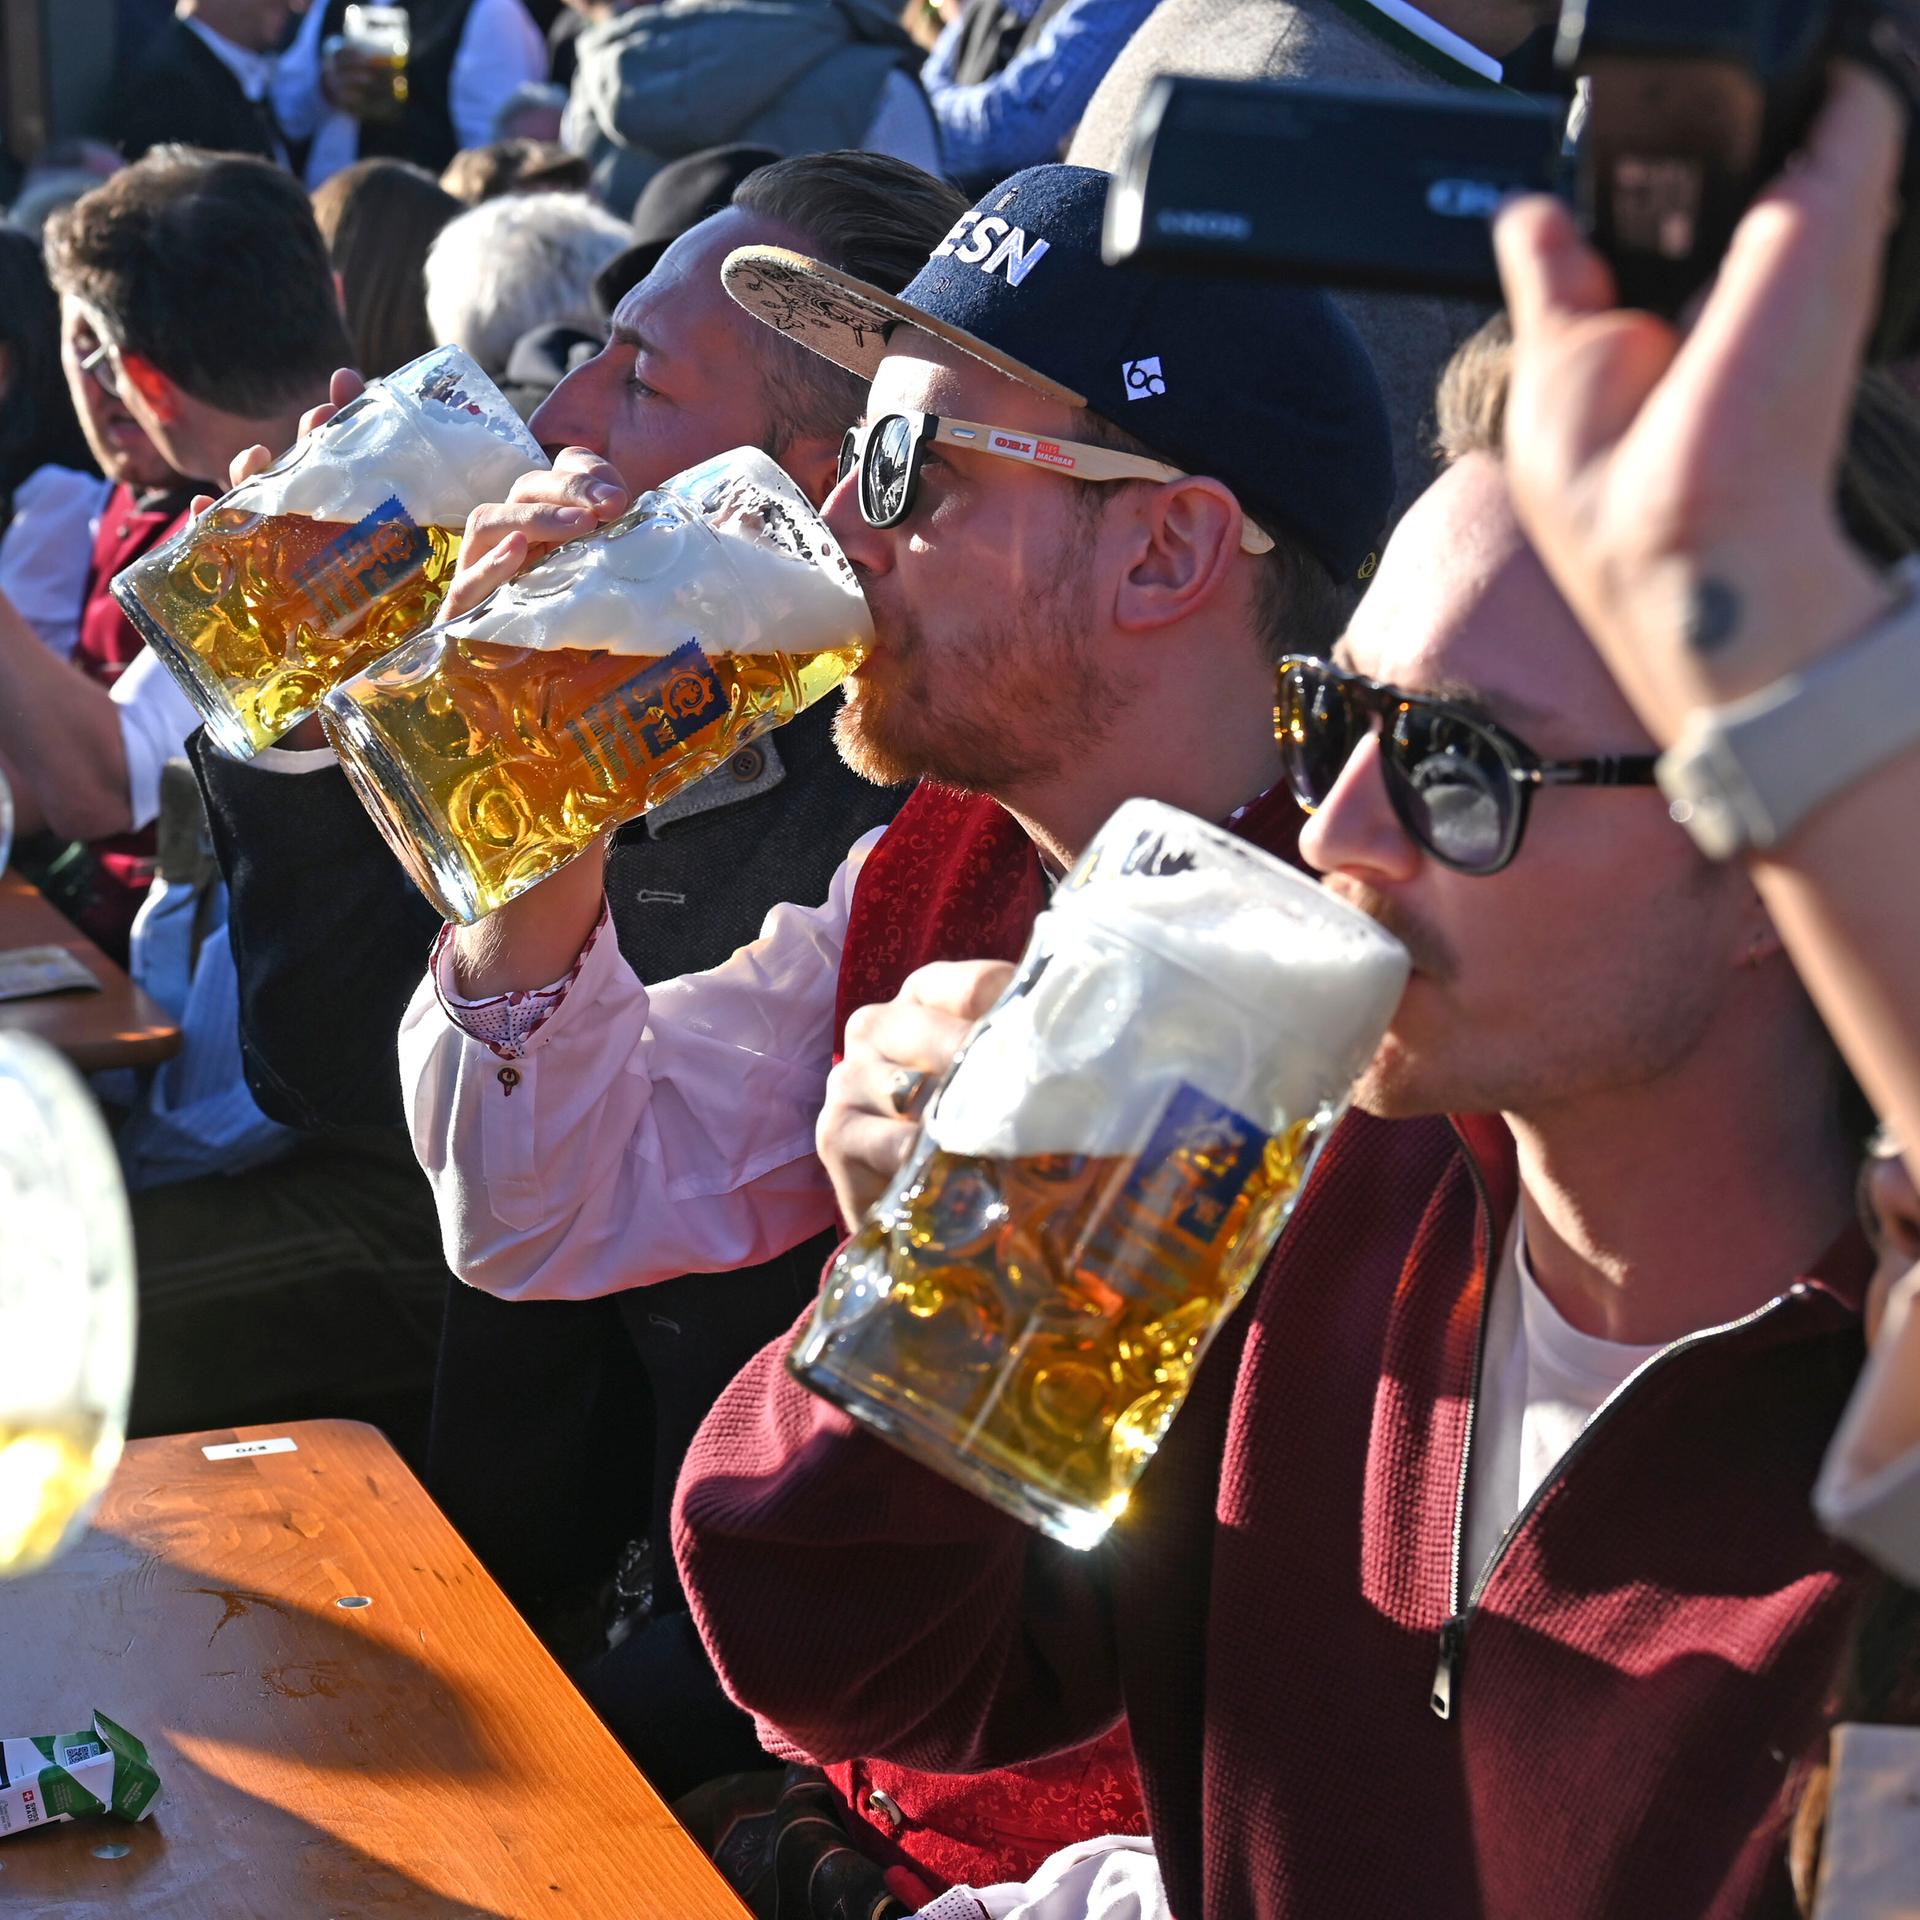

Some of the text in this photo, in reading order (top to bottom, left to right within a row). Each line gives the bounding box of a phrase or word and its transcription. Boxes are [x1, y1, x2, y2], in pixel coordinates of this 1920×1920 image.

[994, 437, 1031, 453] OBI
[1038, 443, 1058, 454] ALLES
[1036, 453, 1073, 466] MACHBAR
